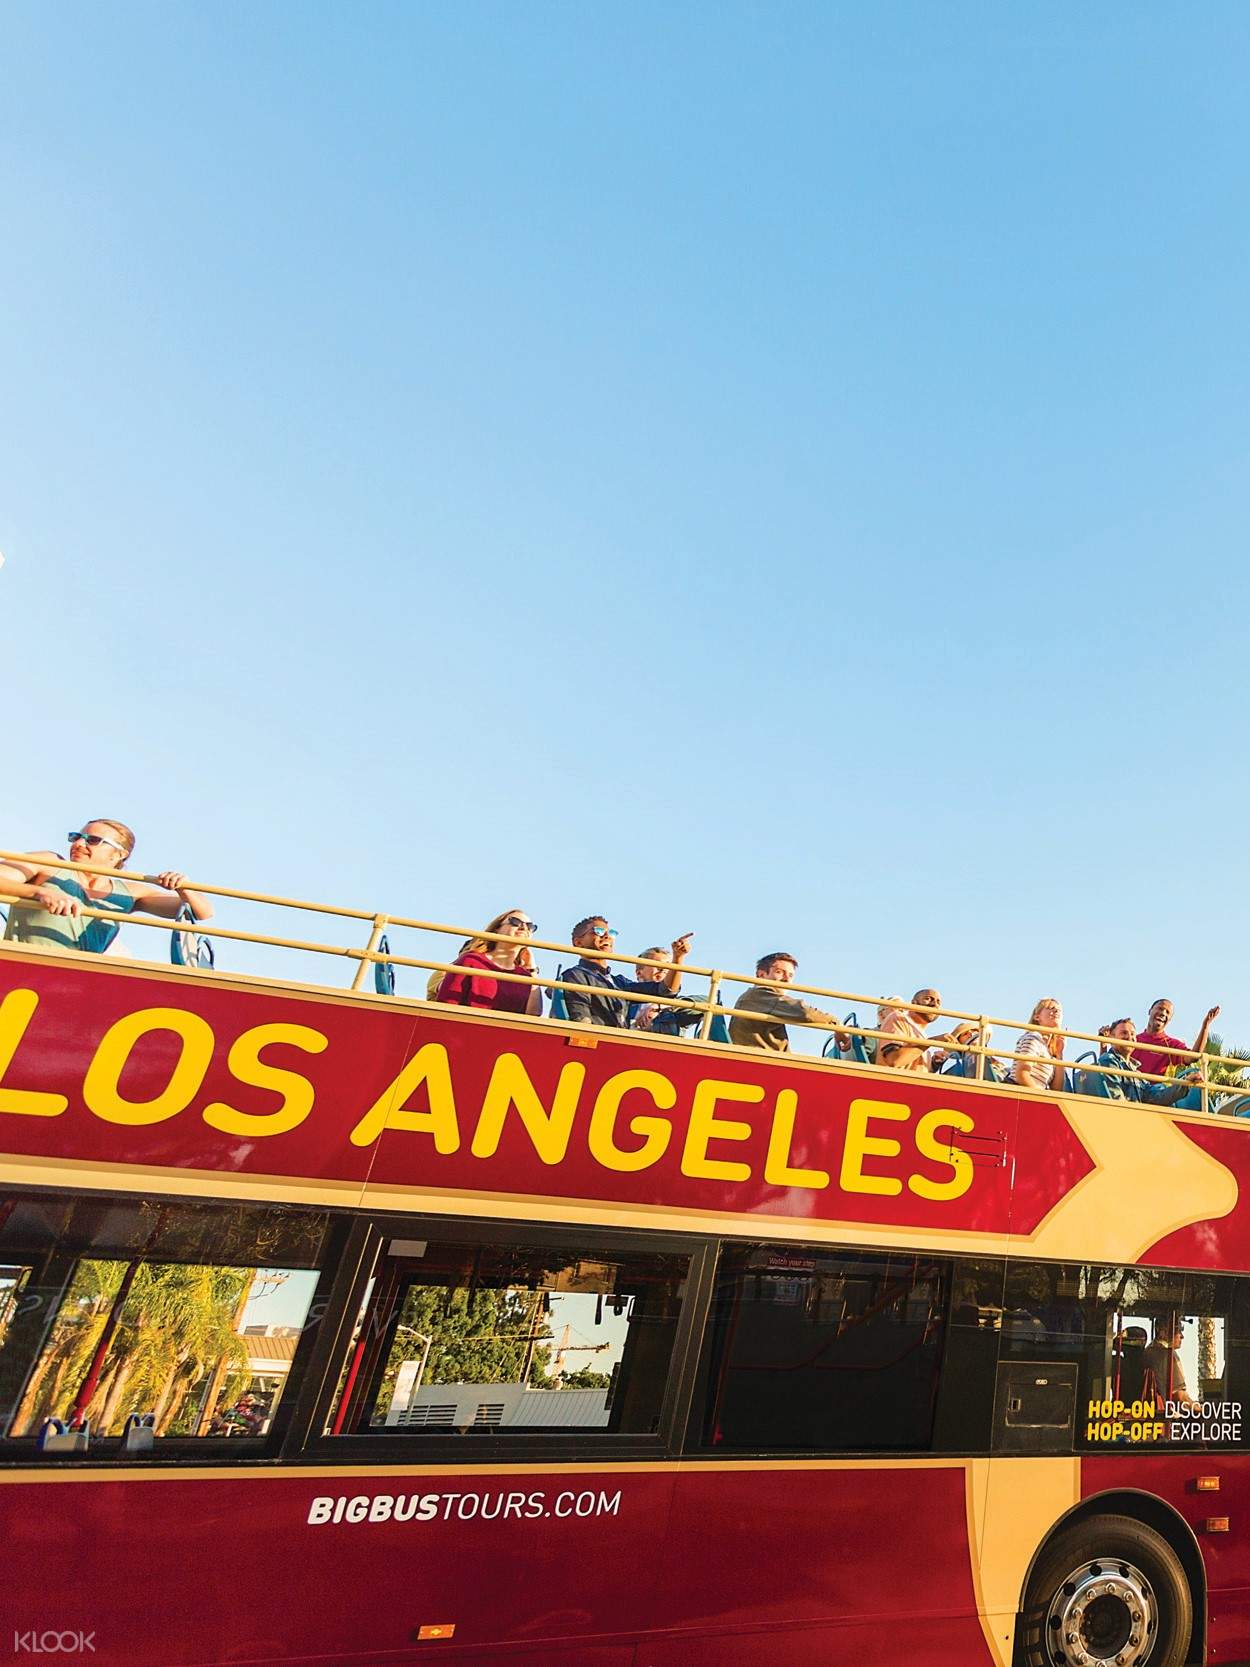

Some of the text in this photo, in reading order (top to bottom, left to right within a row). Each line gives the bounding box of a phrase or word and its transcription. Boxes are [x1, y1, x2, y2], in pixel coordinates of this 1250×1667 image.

[0, 988, 976, 1202] LOS ANGELES
[1088, 1400, 1242, 1420] HOP-ON DISCOVER
[1087, 1422, 1242, 1441] HOP-OFF EXPLORE
[307, 1490, 622, 1525] BIGBUSTOURS.COM
